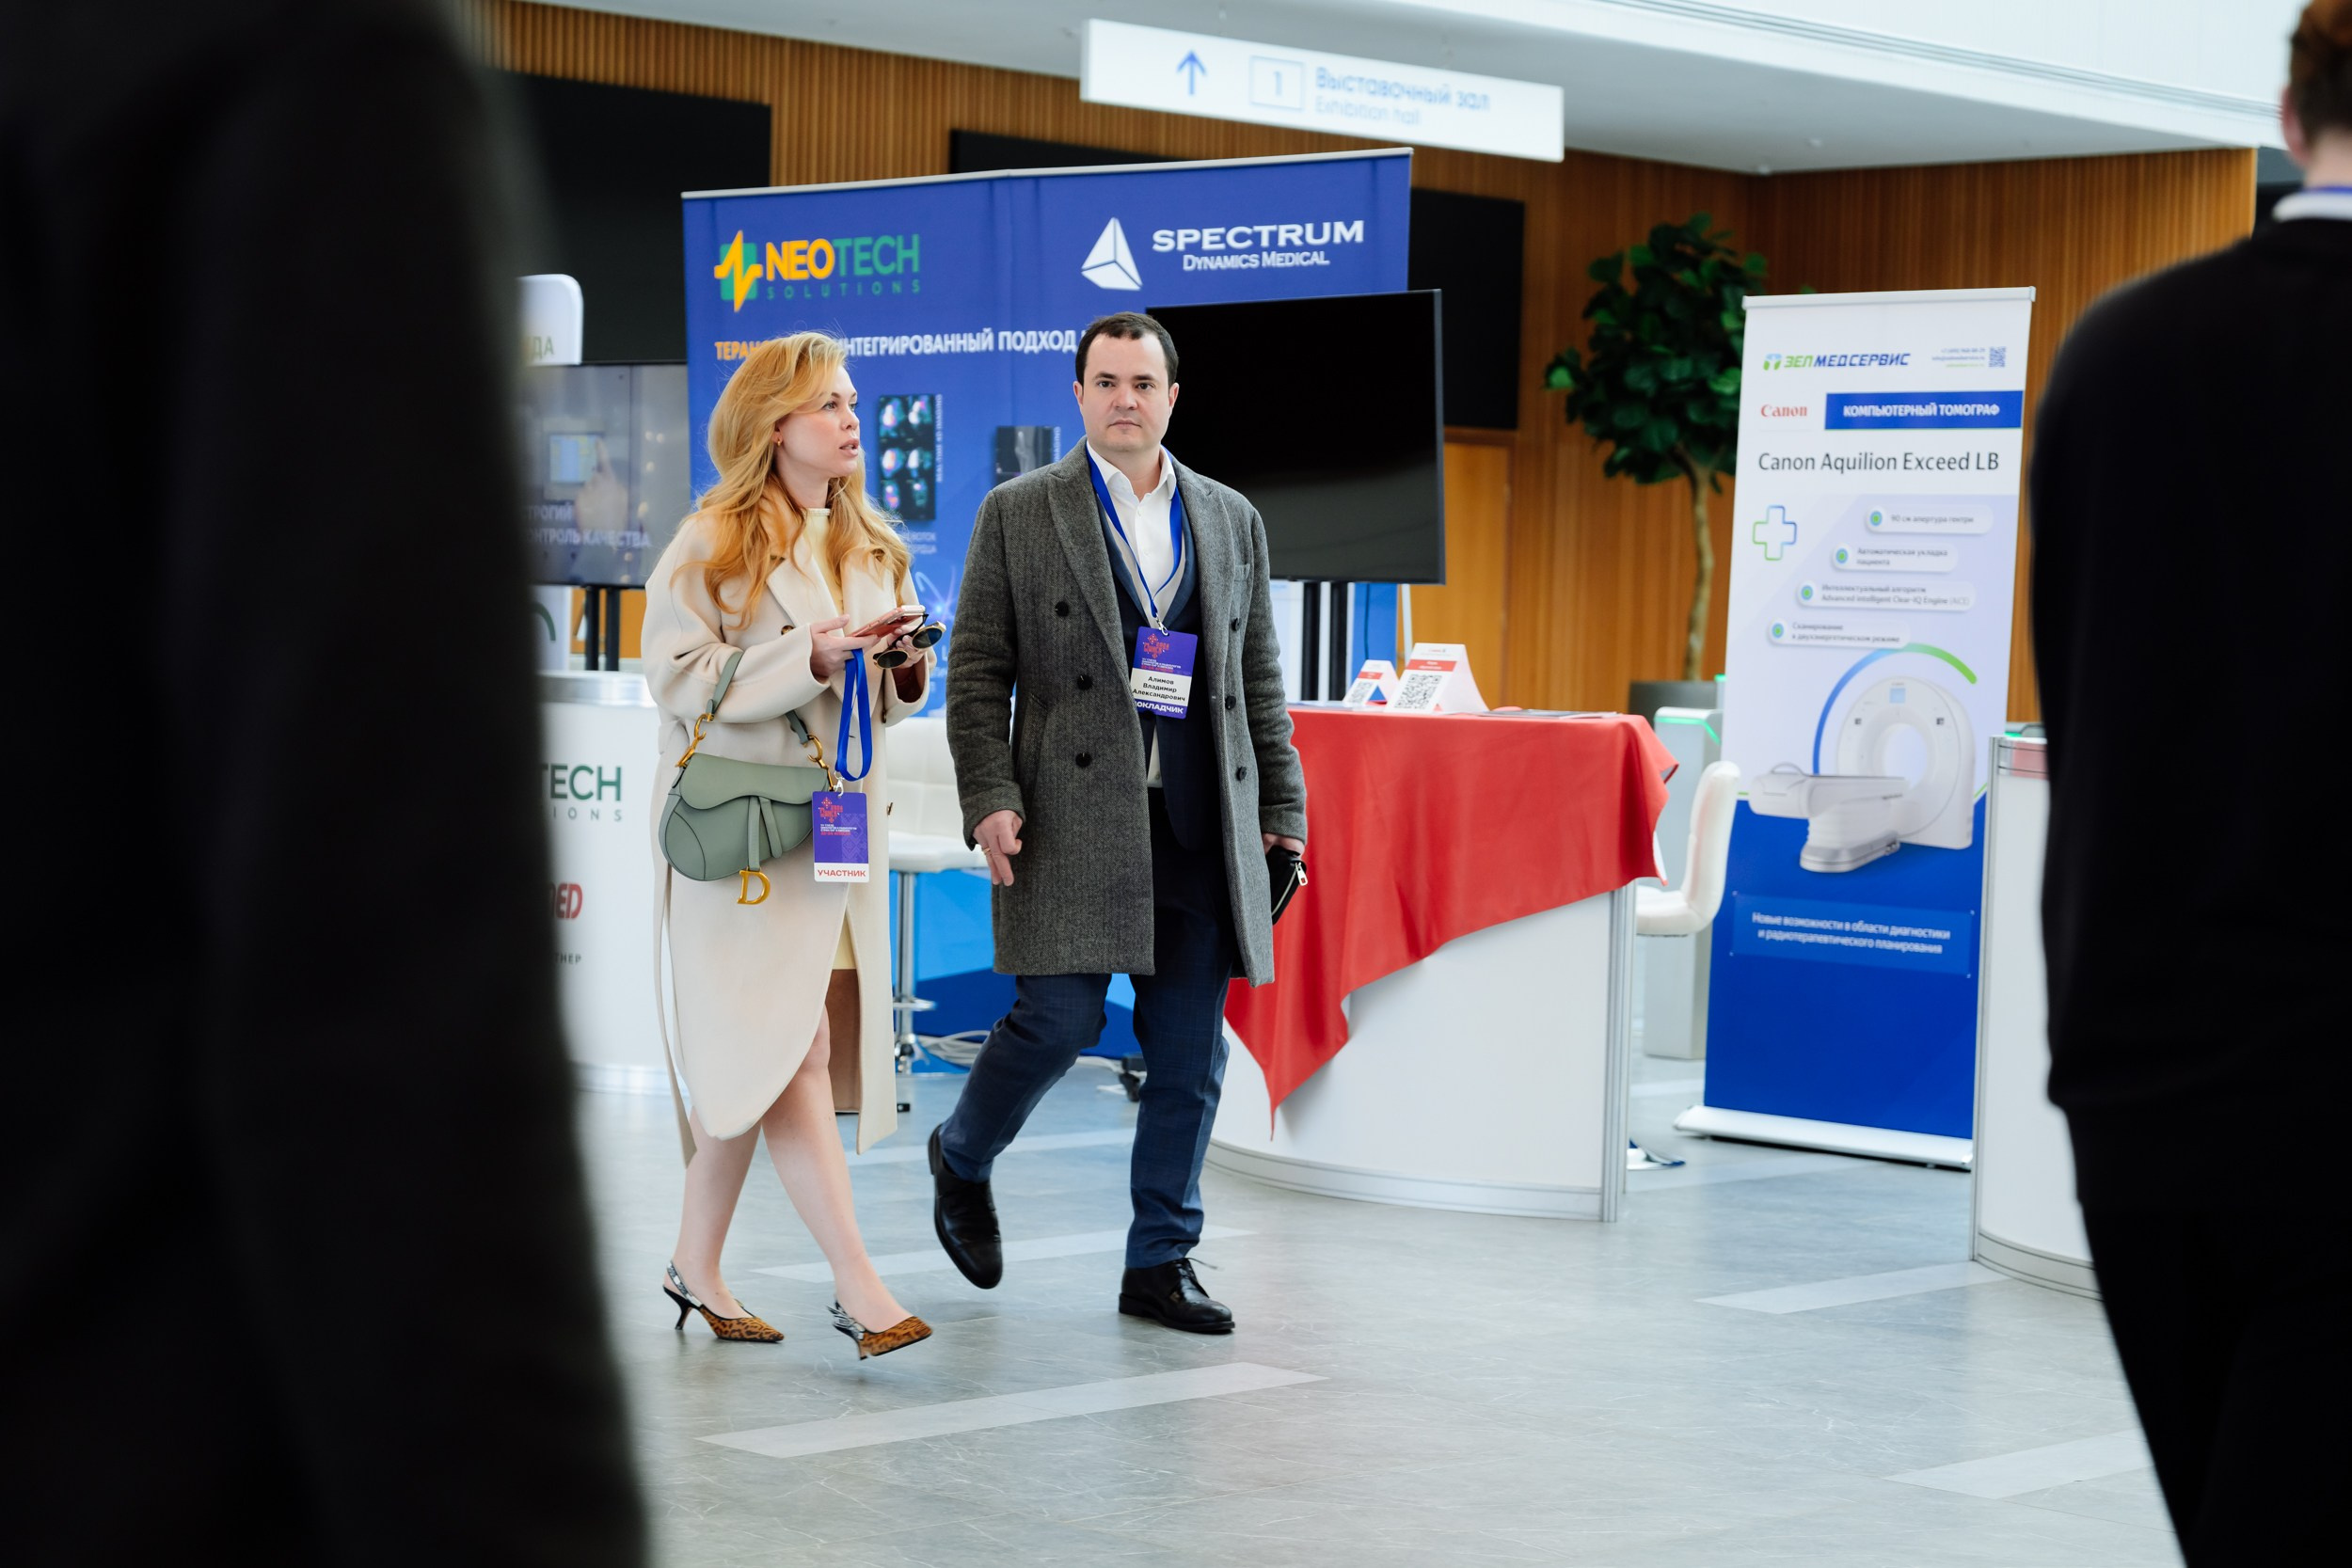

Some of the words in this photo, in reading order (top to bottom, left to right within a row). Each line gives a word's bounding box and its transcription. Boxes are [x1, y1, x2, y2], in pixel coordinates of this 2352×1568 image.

[1273, 71, 1284, 96] 1
[1315, 67, 1452, 104] Выставочный
[1457, 90, 1490, 111] зал
[1315, 96, 1389, 120] Exhibition
[1393, 107, 1420, 125] hall
[1152, 220, 1365, 252] SPECTRUM
[766, 233, 920, 281] NEOTECH
[767, 279, 921, 301] SOLUTIONS
[997, 329, 1078, 355] ПОДХОД
[1784, 352, 1912, 369] ЗЕЛМЕДСЕРВИС
[1759, 403, 1808, 418] Canon
[1843, 402, 1938, 418] КОМПЬЮТЕРНЫЙ
[1939, 404, 2000, 417] ТОМОГРАФ
[1758, 452, 1816, 471] Canon
[1820, 451, 1898, 474] Aquilion
[1903, 451, 1970, 471] Exceed
[1976, 452, 2000, 470] LB
[527, 501, 573, 521] ТРОГИЙ
[583, 529, 652, 548] КАЧЕСТВА
[1142, 683, 1177, 693] Владимир
[1148, 675, 1174, 686] Алимов
[1132, 689, 1185, 702] Александрович
[817, 869, 866, 878] УЧАСТНИК
[737, 869, 771, 905] D
[1752, 911, 1783, 926] Новые
[1783, 915, 1844, 931] возможности
[1844, 921, 1851, 931] в
[1851, 919, 1889, 935] области
[1889, 925, 1950, 941] диагностики
[1757, 928, 1765, 939] и
[1765, 929, 1875, 949] радиотерапевтического
[1875, 938, 1943, 955] планирования
